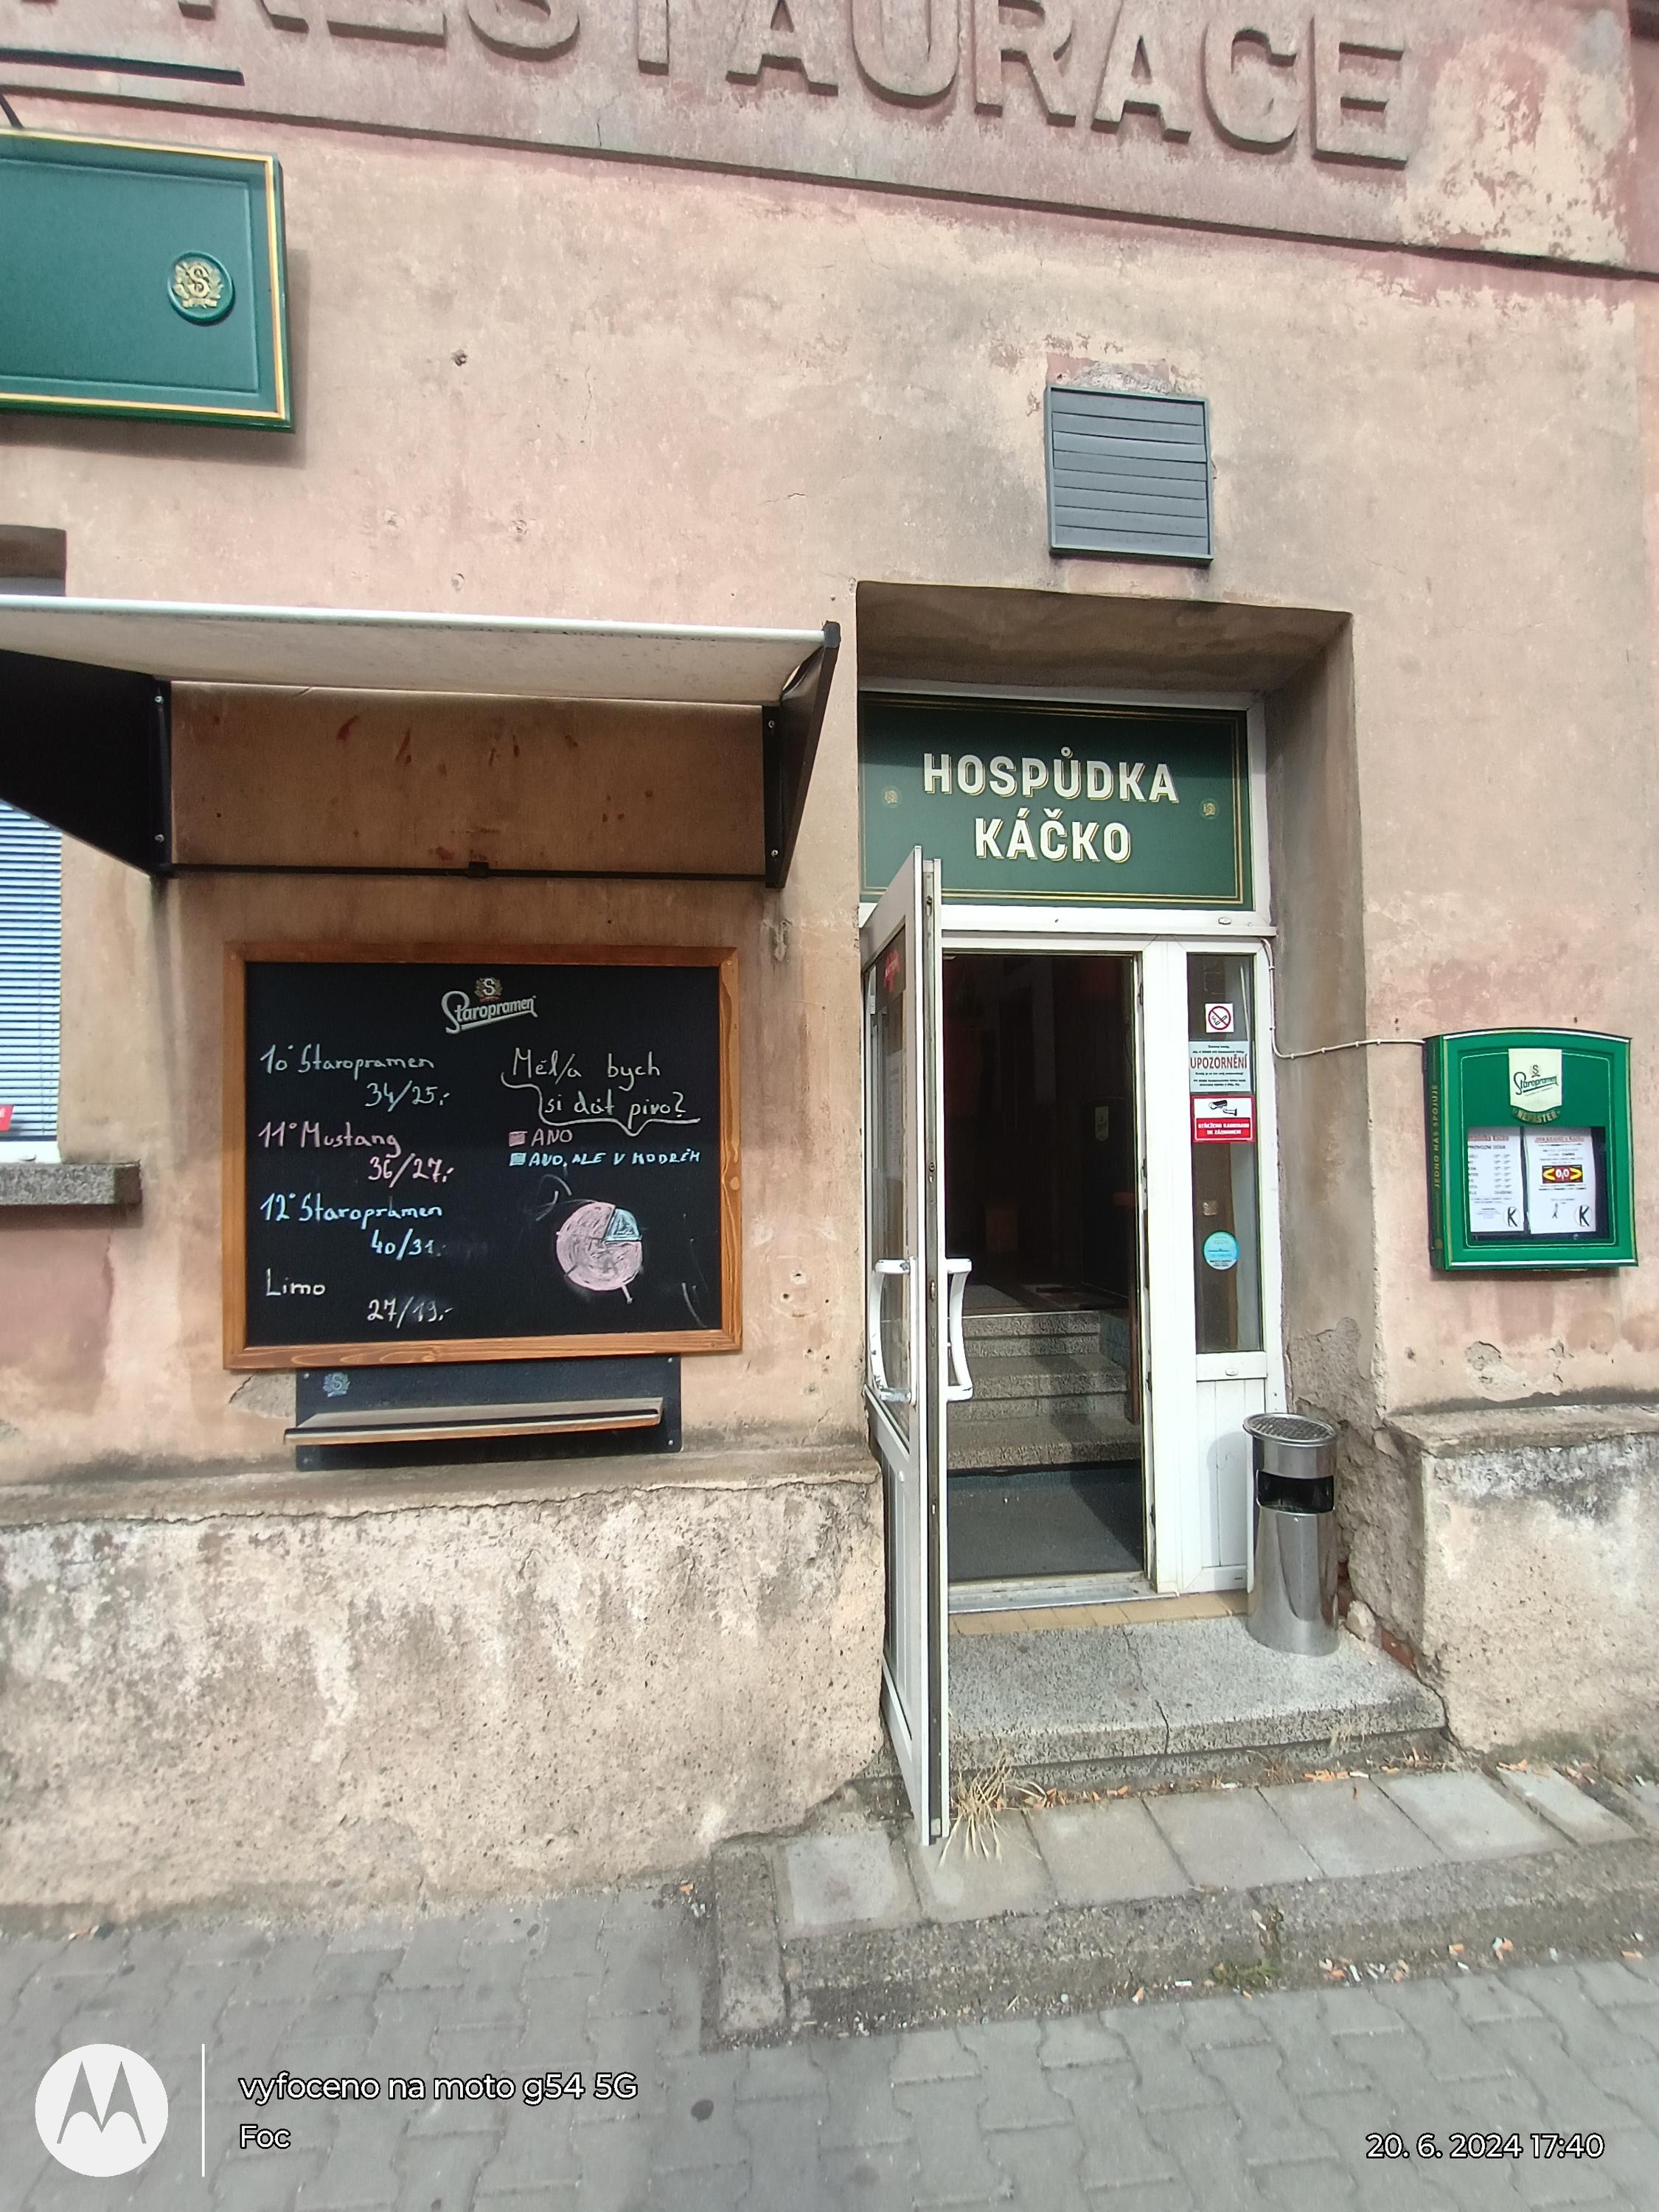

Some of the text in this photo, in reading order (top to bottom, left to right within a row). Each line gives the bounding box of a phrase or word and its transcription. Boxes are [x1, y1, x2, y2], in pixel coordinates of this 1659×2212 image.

[177, 0, 1407, 170] AURACE
[923, 746, 1180, 804] HOSPŮDKA
[975, 808, 1133, 864] KÁČKO
[441, 990, 538, 1034] Staropramen
[297, 1043, 435, 1081] Staropramen
[607, 1051, 661, 1091] bych
[1190, 1054, 1248, 1069] UPOZORNĚNÍ
[544, 1088, 686, 1130] si dát pivo?
[299, 1121, 402, 1158] Mustang
[531, 1128, 574, 1147] ANO
[571, 1152, 607, 1166] ALE
[613, 1152, 625, 1166] V
[298, 1192, 443, 1230] Staropramen
[265, 1267, 326, 1296] Limo
